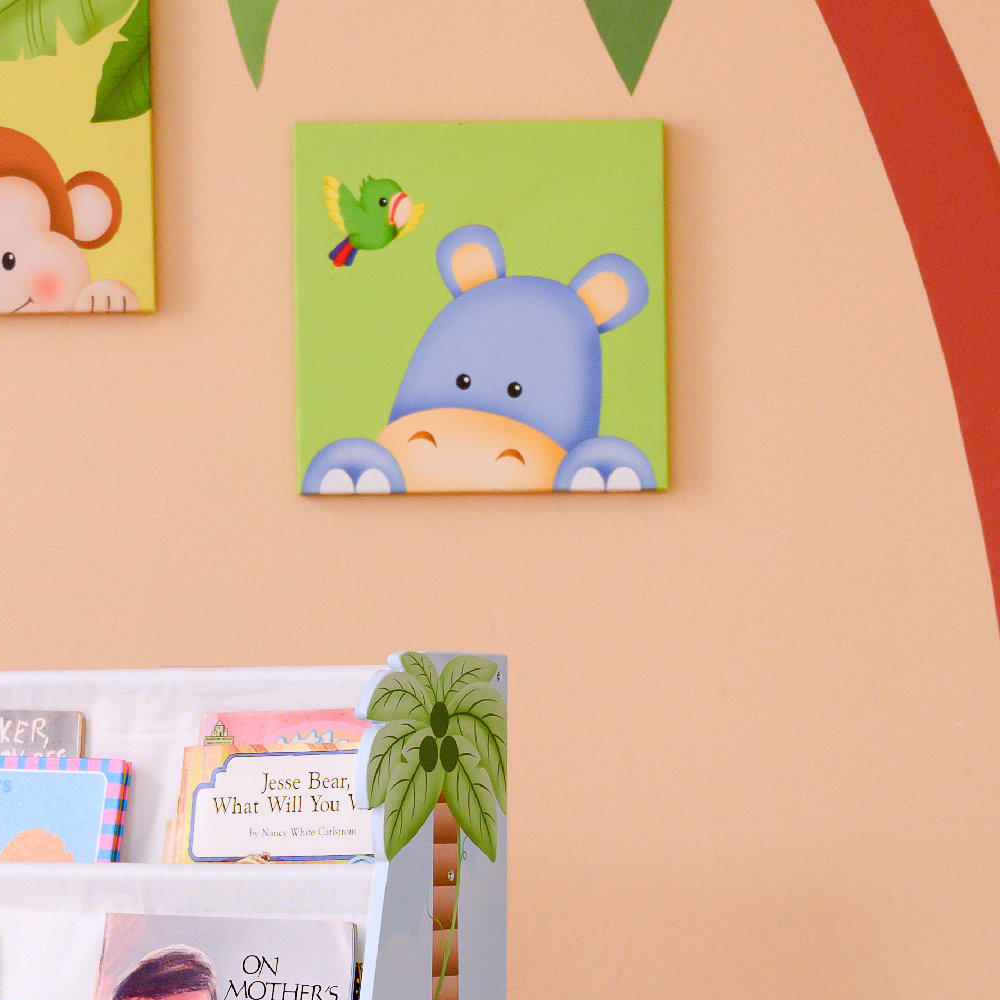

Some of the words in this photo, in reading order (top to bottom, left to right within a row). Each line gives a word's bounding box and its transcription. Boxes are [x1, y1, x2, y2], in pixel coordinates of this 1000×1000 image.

[261, 772, 301, 794] Jesse
[308, 771, 350, 791] Bear,
[213, 796, 259, 814] What
[267, 795, 302, 813] Will
[310, 794, 340, 812] You
[249, 827, 258, 838] by
[261, 828, 287, 838] Nancy
[290, 827, 316, 837] White
[242, 954, 279, 977] ON
